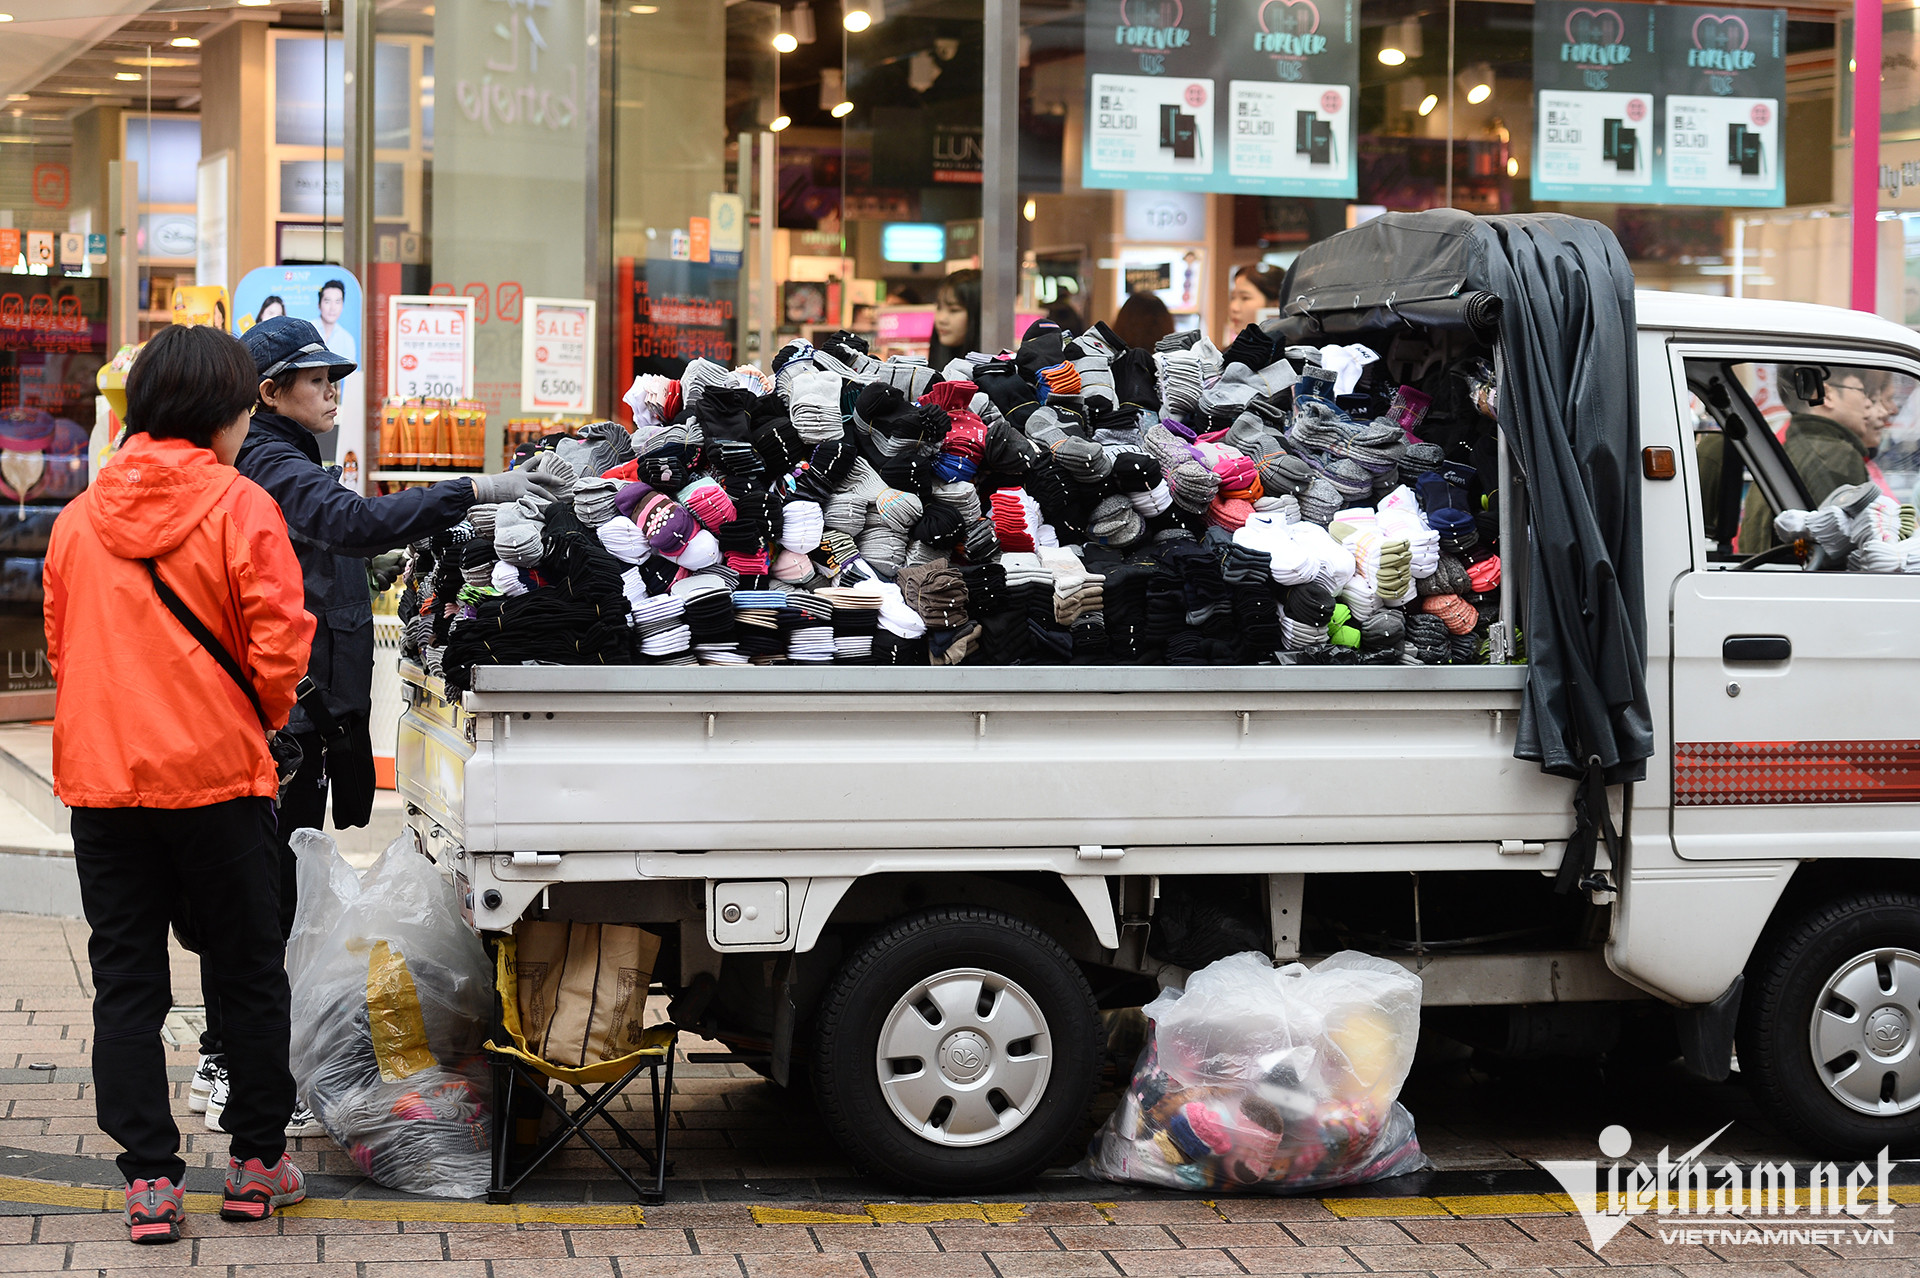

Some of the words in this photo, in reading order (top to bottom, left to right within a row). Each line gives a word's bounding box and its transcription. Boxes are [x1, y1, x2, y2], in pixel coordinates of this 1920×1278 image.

[1115, 25, 1191, 49] FOREVER
[1253, 32, 1327, 56] FOREVER
[1560, 42, 1632, 66] FOREVER
[1687, 48, 1757, 71] FOREVER
[933, 135, 984, 161] LUN
[400, 319, 462, 335] SALE
[536, 320, 583, 336] SALE
[8, 648, 52, 679] LUN
